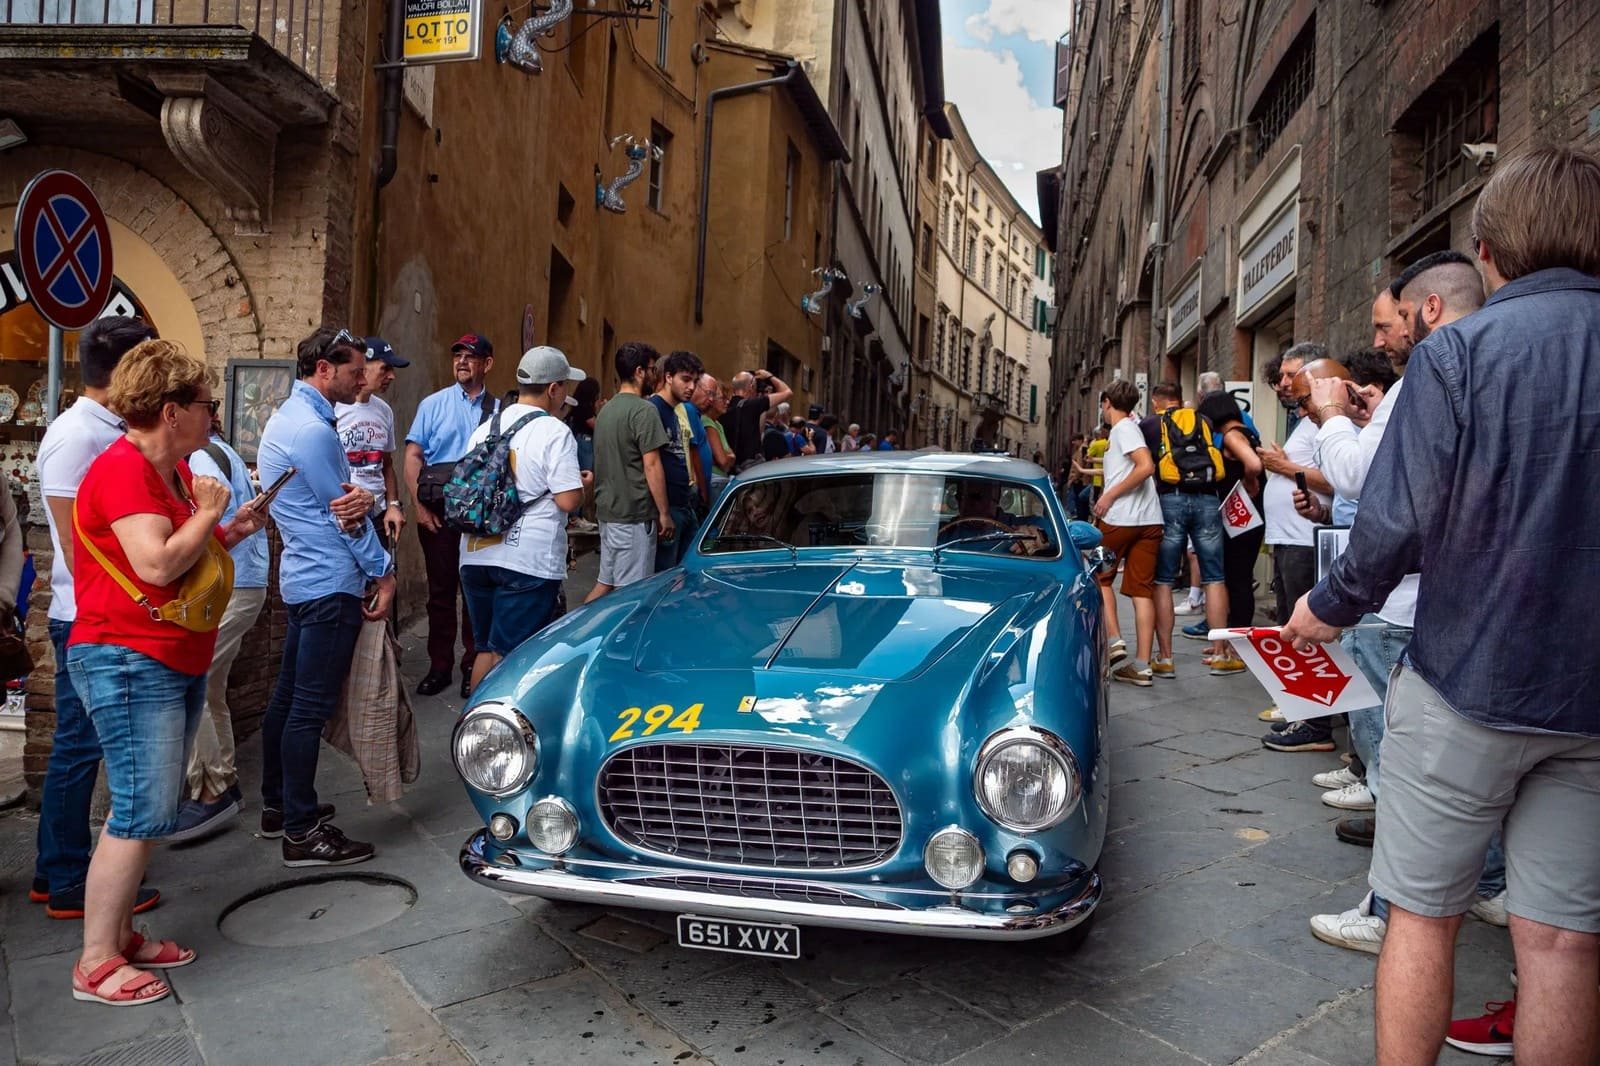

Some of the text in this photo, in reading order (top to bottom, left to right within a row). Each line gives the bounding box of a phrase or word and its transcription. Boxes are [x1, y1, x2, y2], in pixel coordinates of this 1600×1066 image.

[408, 2, 435, 12] VALORI
[406, 19, 468, 39] LOTTO
[444, 36, 457, 45] 191
[1243, 228, 1295, 295] VALLEVERDE
[1260, 638, 1304, 681] 100
[1296, 643, 1338, 678] MIG
[608, 703, 704, 743] 294
[689, 922, 789, 952] 651 XVX
